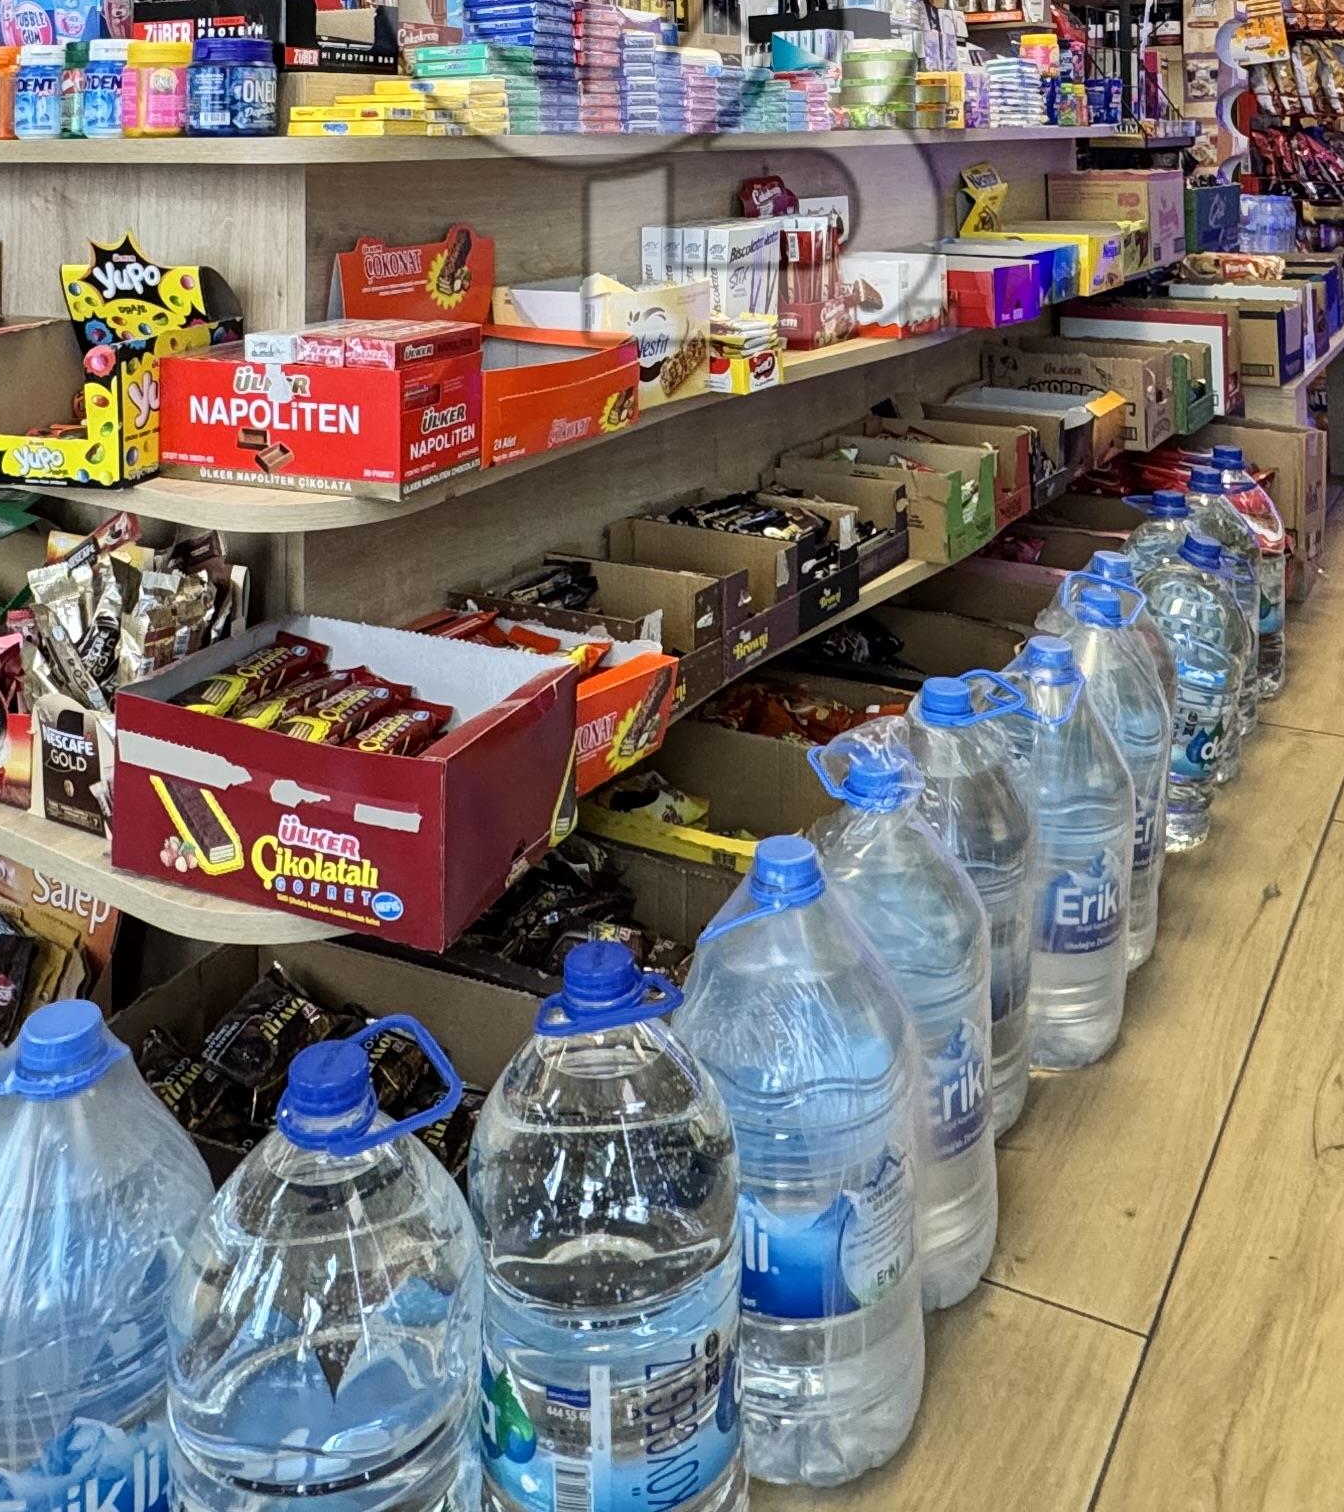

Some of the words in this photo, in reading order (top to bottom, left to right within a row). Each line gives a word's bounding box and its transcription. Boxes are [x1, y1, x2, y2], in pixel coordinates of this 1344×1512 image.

[198, 25, 264, 38] PROTEIN
[335, 52, 374, 64] PROTEIN
[364, 250, 422, 282] ÇOKONAT
[118, 304, 147, 315] DRAJE
[421, 403, 467, 434] ÜLKER
[199, 467, 233, 481] ÜLKER
[298, 477, 353, 491] ÇİKOLATA
[50, 748, 88, 772] GOLD
[279, 816, 360, 859] ÜLKER
[251, 835, 379, 891] Çikolatalı
[32, 868, 111, 935] Salep
[275, 876, 372, 906] GOFRET
[1054, 880, 1119, 928] Erik
